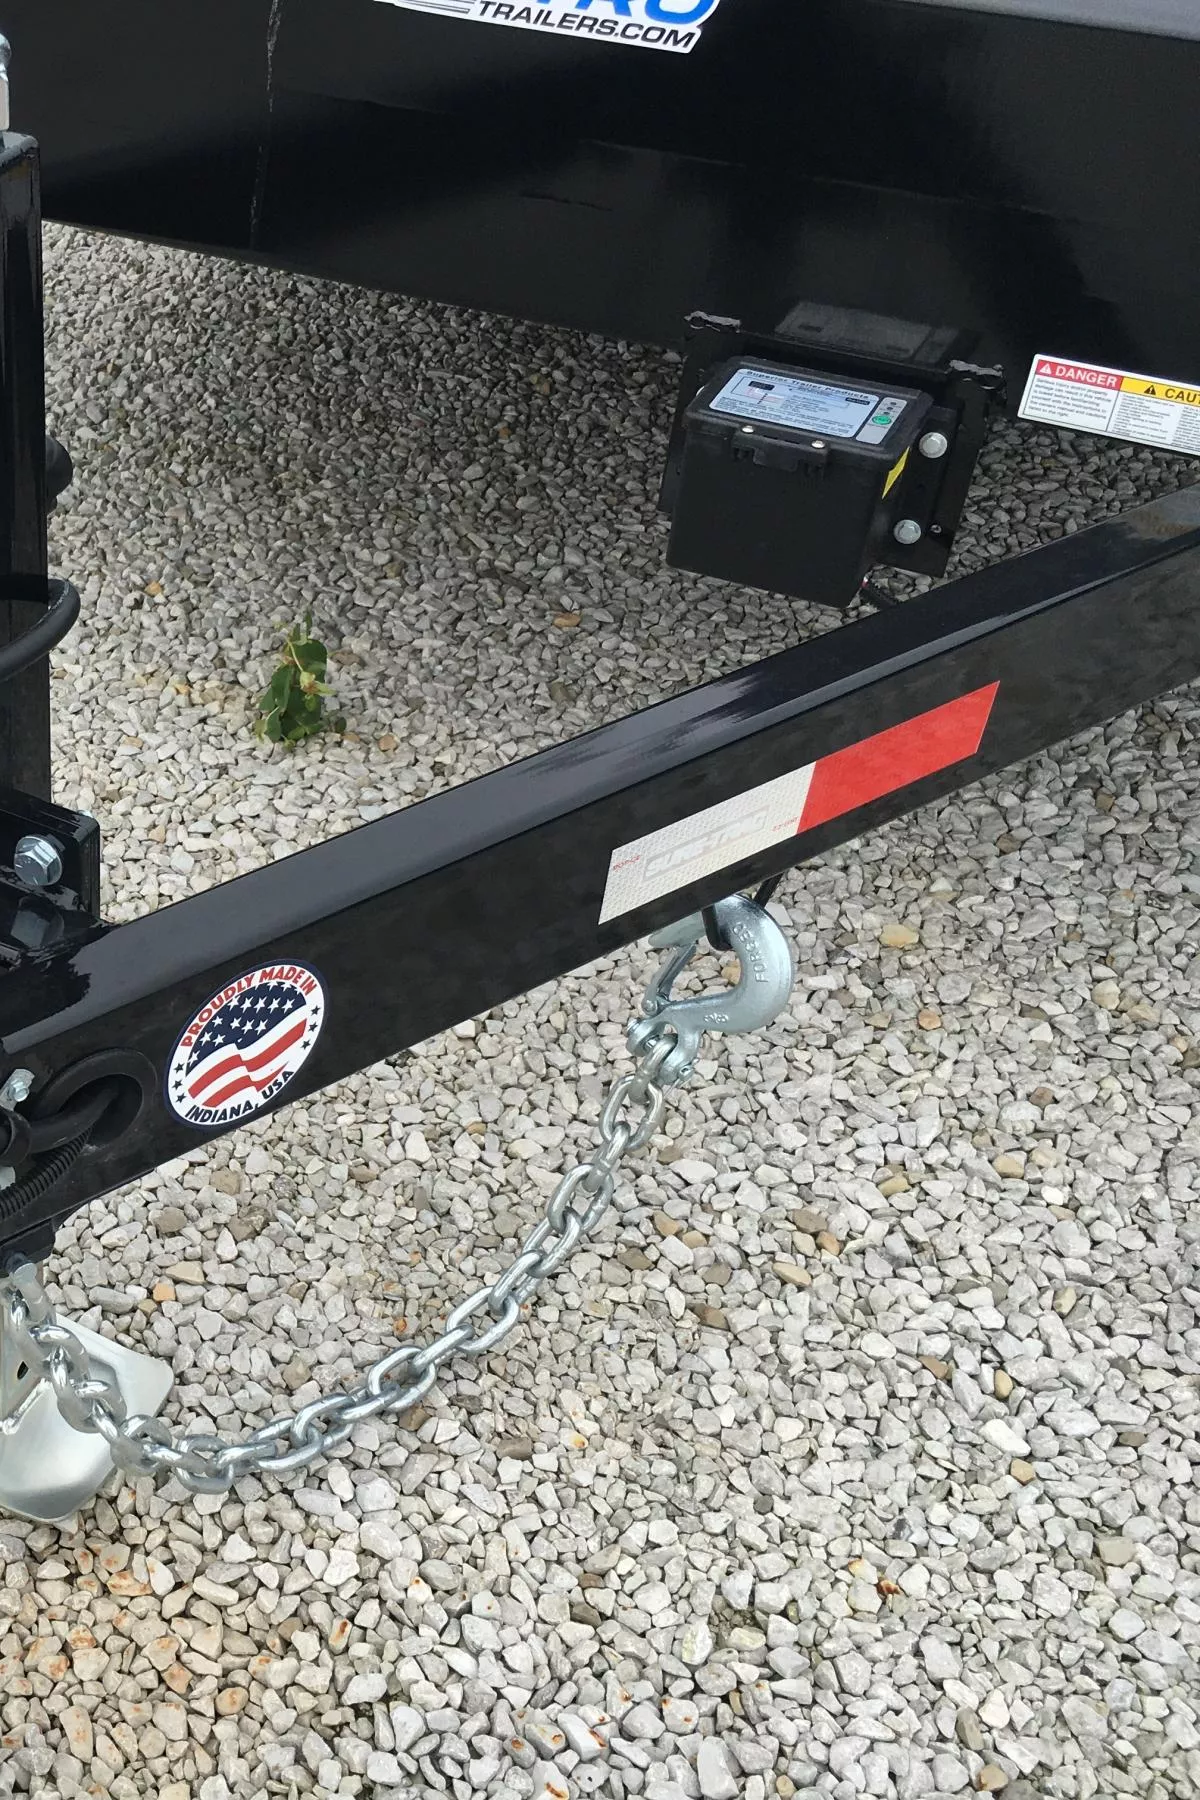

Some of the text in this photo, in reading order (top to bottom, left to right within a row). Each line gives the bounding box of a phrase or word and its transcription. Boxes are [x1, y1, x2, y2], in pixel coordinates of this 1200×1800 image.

[478, 0, 696, 49] TRAILERS.COM
[792, 379, 823, 390] Trailer
[1056, 366, 1117, 388] DANGER
[732, 921, 769, 983] FORGED
[180, 966, 318, 1048] PROUDLY MADE IN
[185, 1070, 294, 1123] INDIANA, USA
